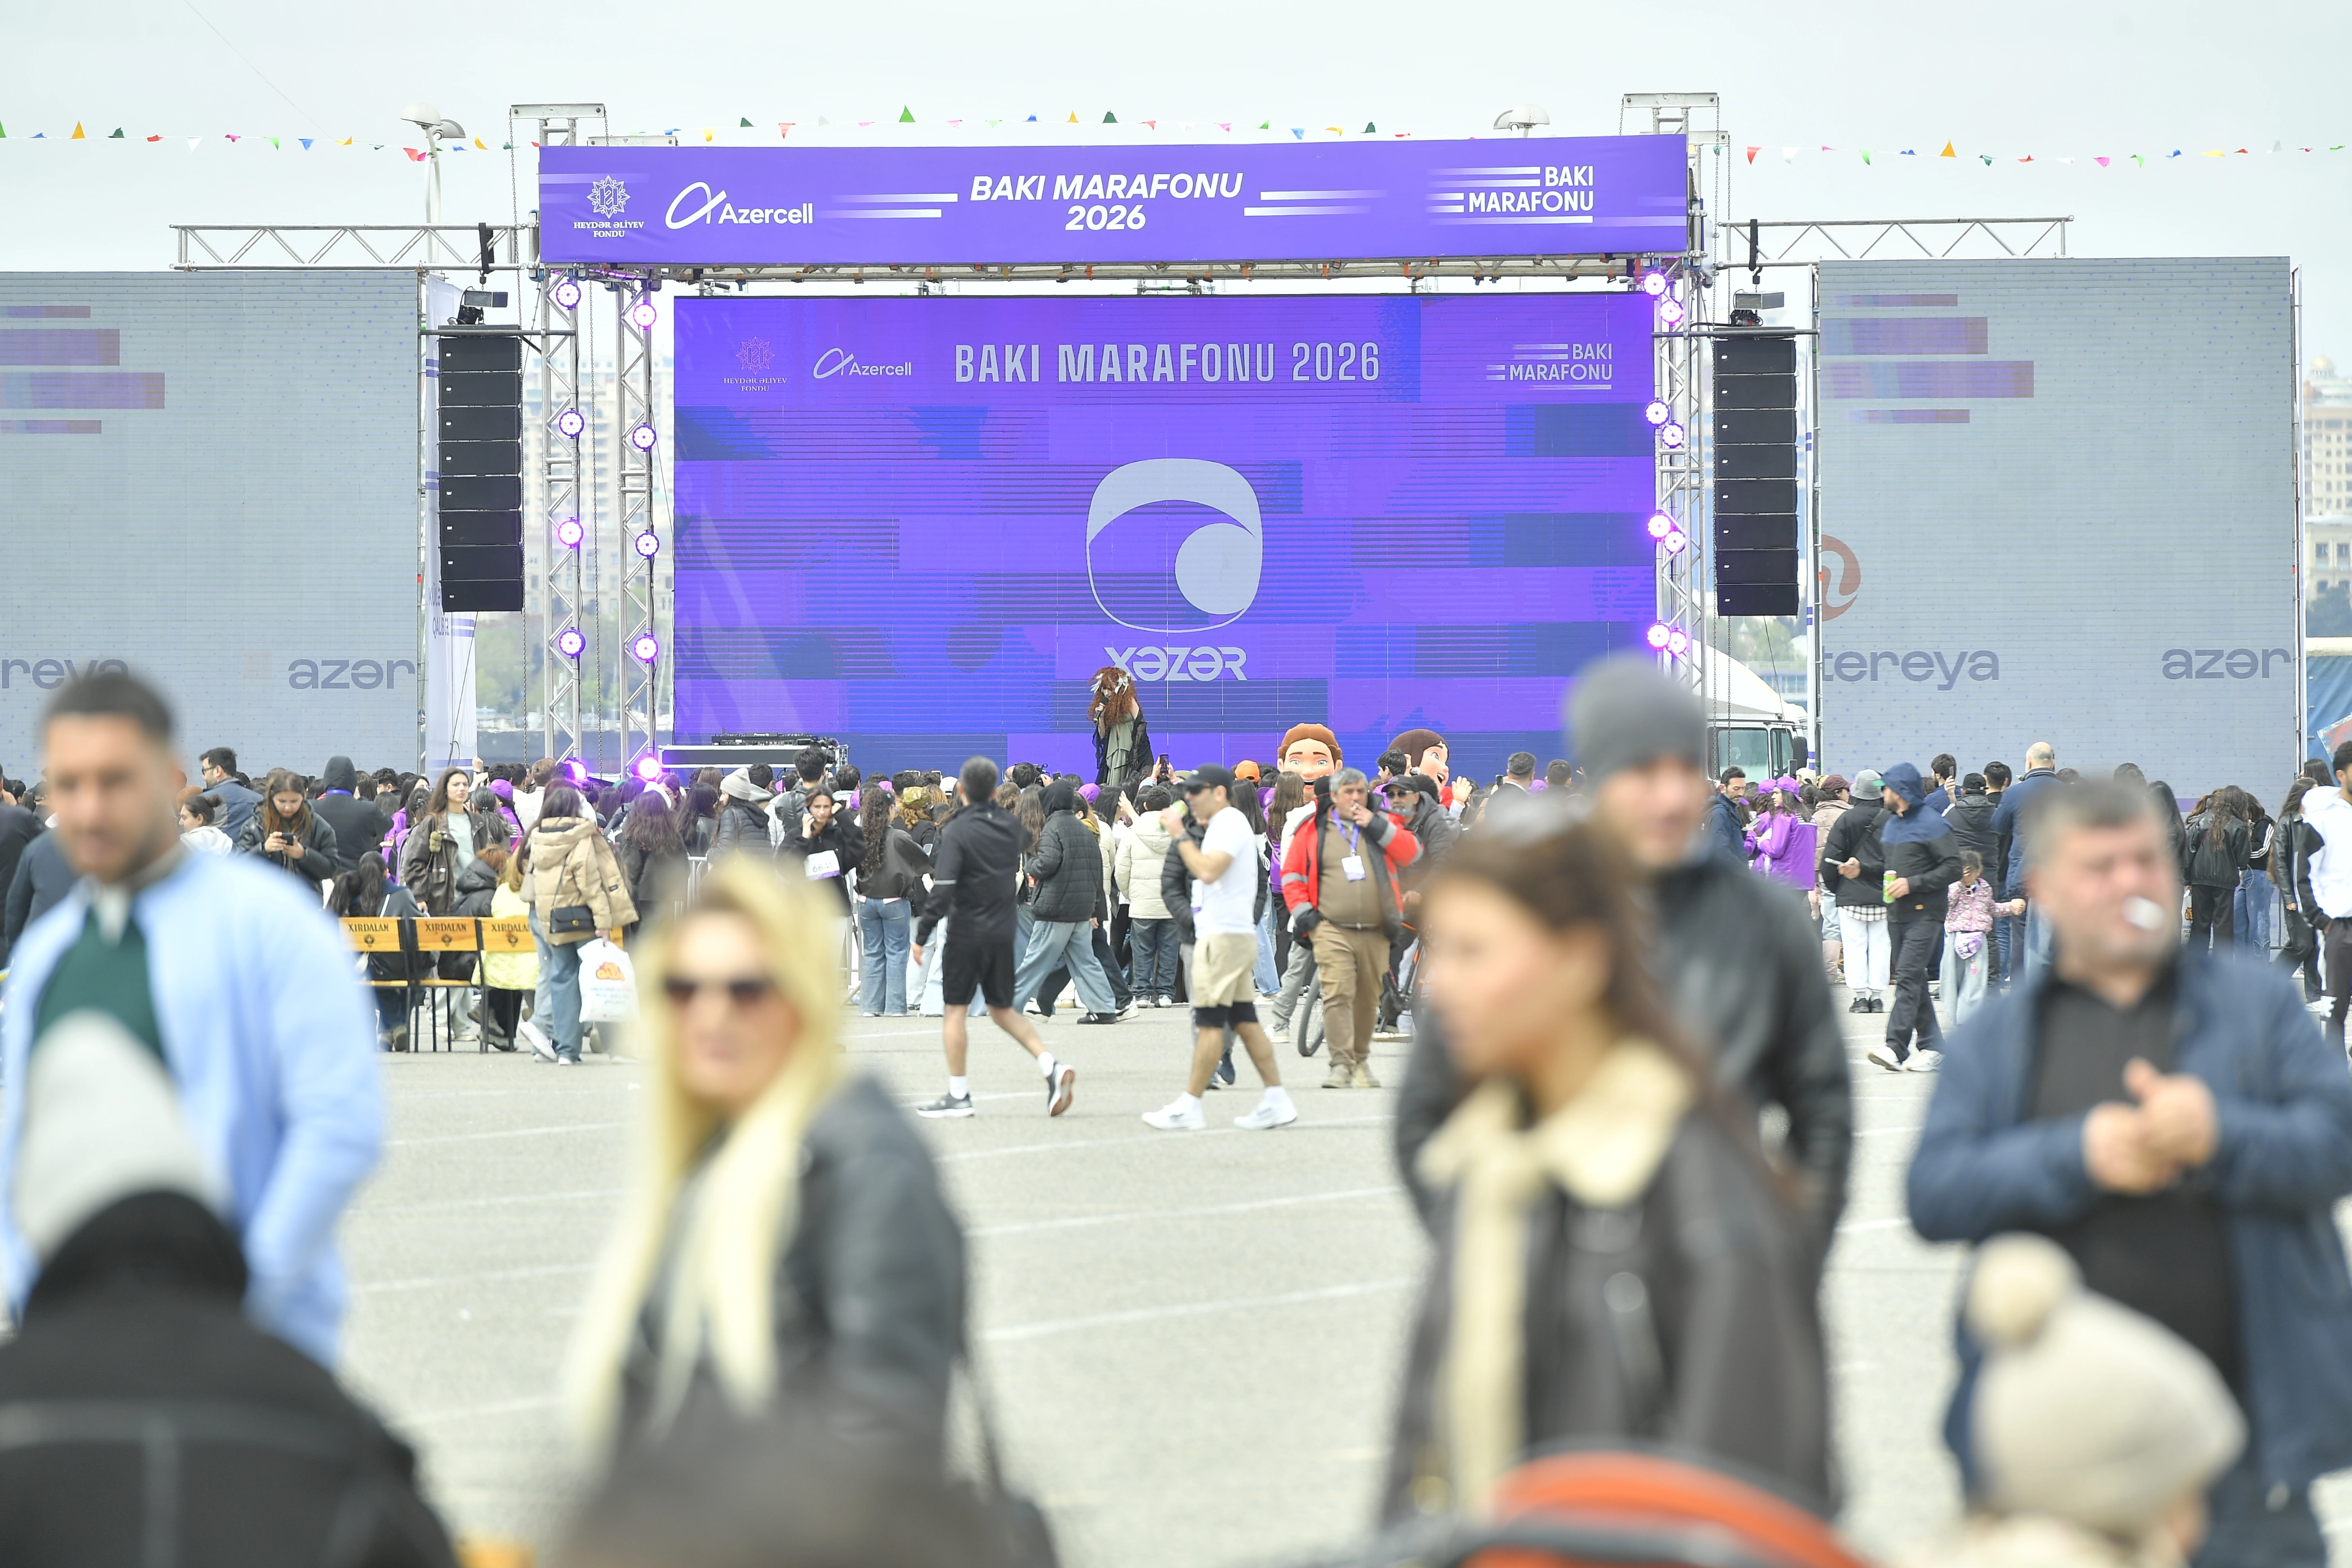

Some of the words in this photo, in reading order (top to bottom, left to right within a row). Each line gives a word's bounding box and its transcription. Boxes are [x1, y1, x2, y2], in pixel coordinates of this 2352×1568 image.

[970, 175, 1046, 201] BAKI
[1053, 172, 1243, 201] MARAFONU
[1545, 166, 1594, 187] BAKI
[1468, 190, 1594, 213] MARAFONU
[613, 220, 644, 229] ƏLİYEV
[718, 203, 813, 225] Azercell
[1065, 204, 1146, 230] 2026
[955, 344, 1040, 382] BAKI
[1057, 343, 1275, 382] MARAFONU
[1292, 342, 1380, 381] 2026
[1572, 343, 1612, 360] BAKI
[848, 362, 912, 376] Azercell
[1509, 364, 1612, 381] MARAFONU
[288, 659, 416, 689] azər
[2162, 648, 2292, 680] azər
[348, 923, 389, 932] XIRDALAN
[426, 923, 467, 932] XIRDALAN
[492, 923, 529, 932] XIRDALA
